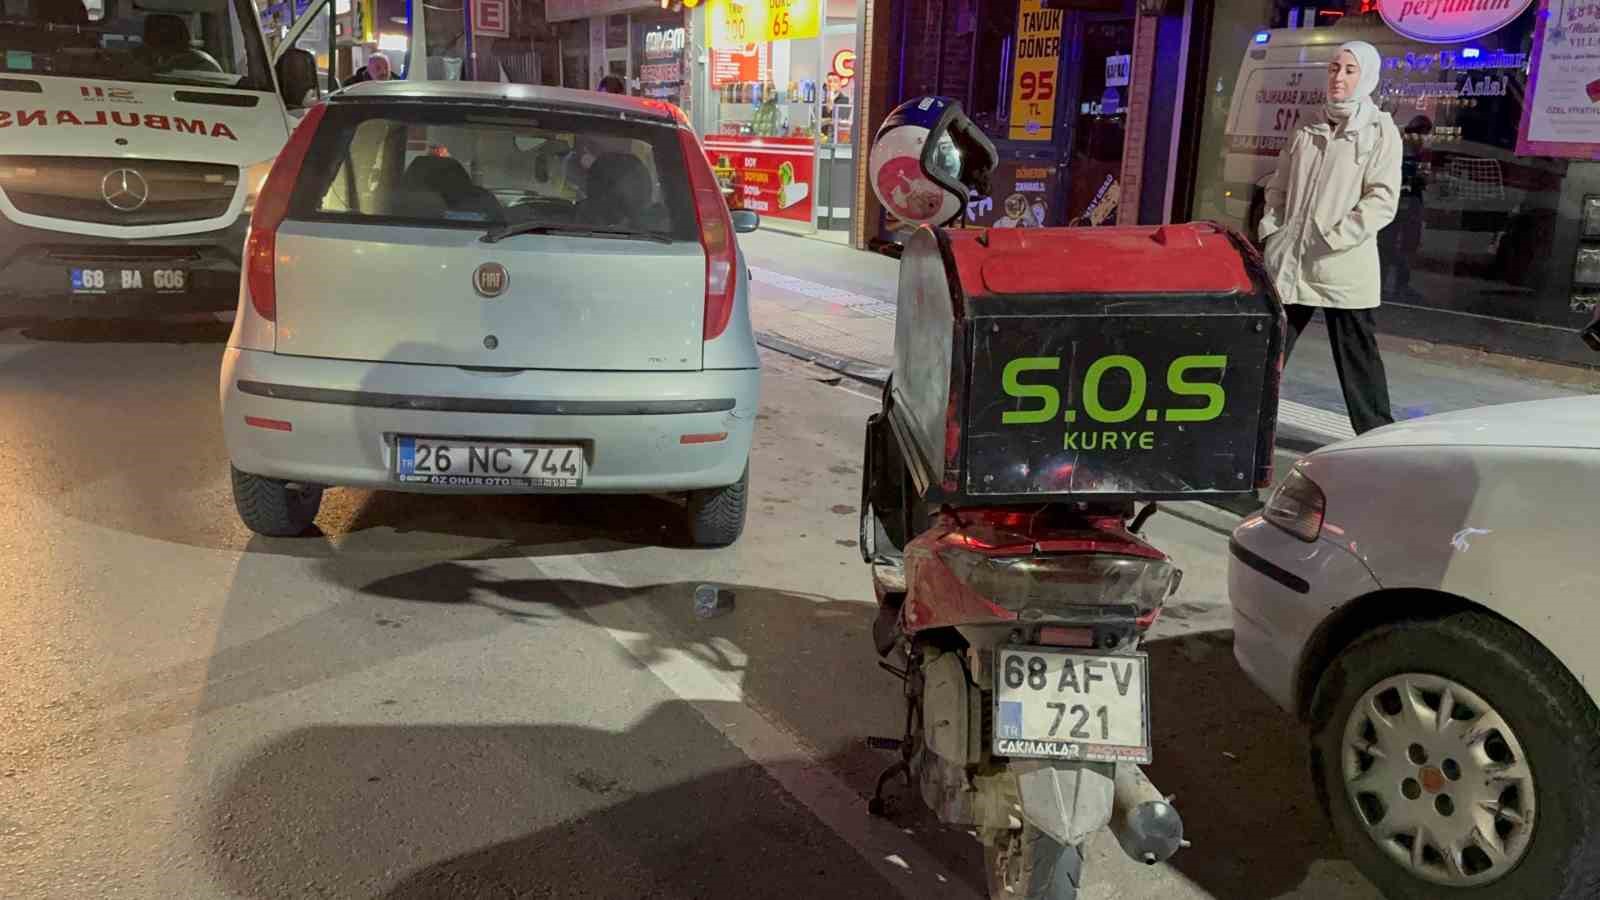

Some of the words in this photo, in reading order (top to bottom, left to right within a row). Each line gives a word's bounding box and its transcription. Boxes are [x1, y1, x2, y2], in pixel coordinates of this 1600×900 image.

[1023, 10, 1060, 33] TAVUK
[1018, 35, 1060, 58] DÖNER
[1020, 70, 1053, 100] 95
[1029, 103, 1041, 116] TL
[82, 269, 105, 289] 68
[482, 272, 501, 288] FIAT
[1001, 355, 1228, 425] S.O.S
[1063, 432, 1154, 450] KURYE
[415, 445, 452, 472] 26
[468, 446, 513, 474] NC
[522, 449, 577, 476] 744
[1004, 655, 1048, 690] 68
[1058, 658, 1133, 696] AFV
[1046, 702, 1109, 740] 721
[999, 739, 1080, 757] ÇAKMAKLAR
